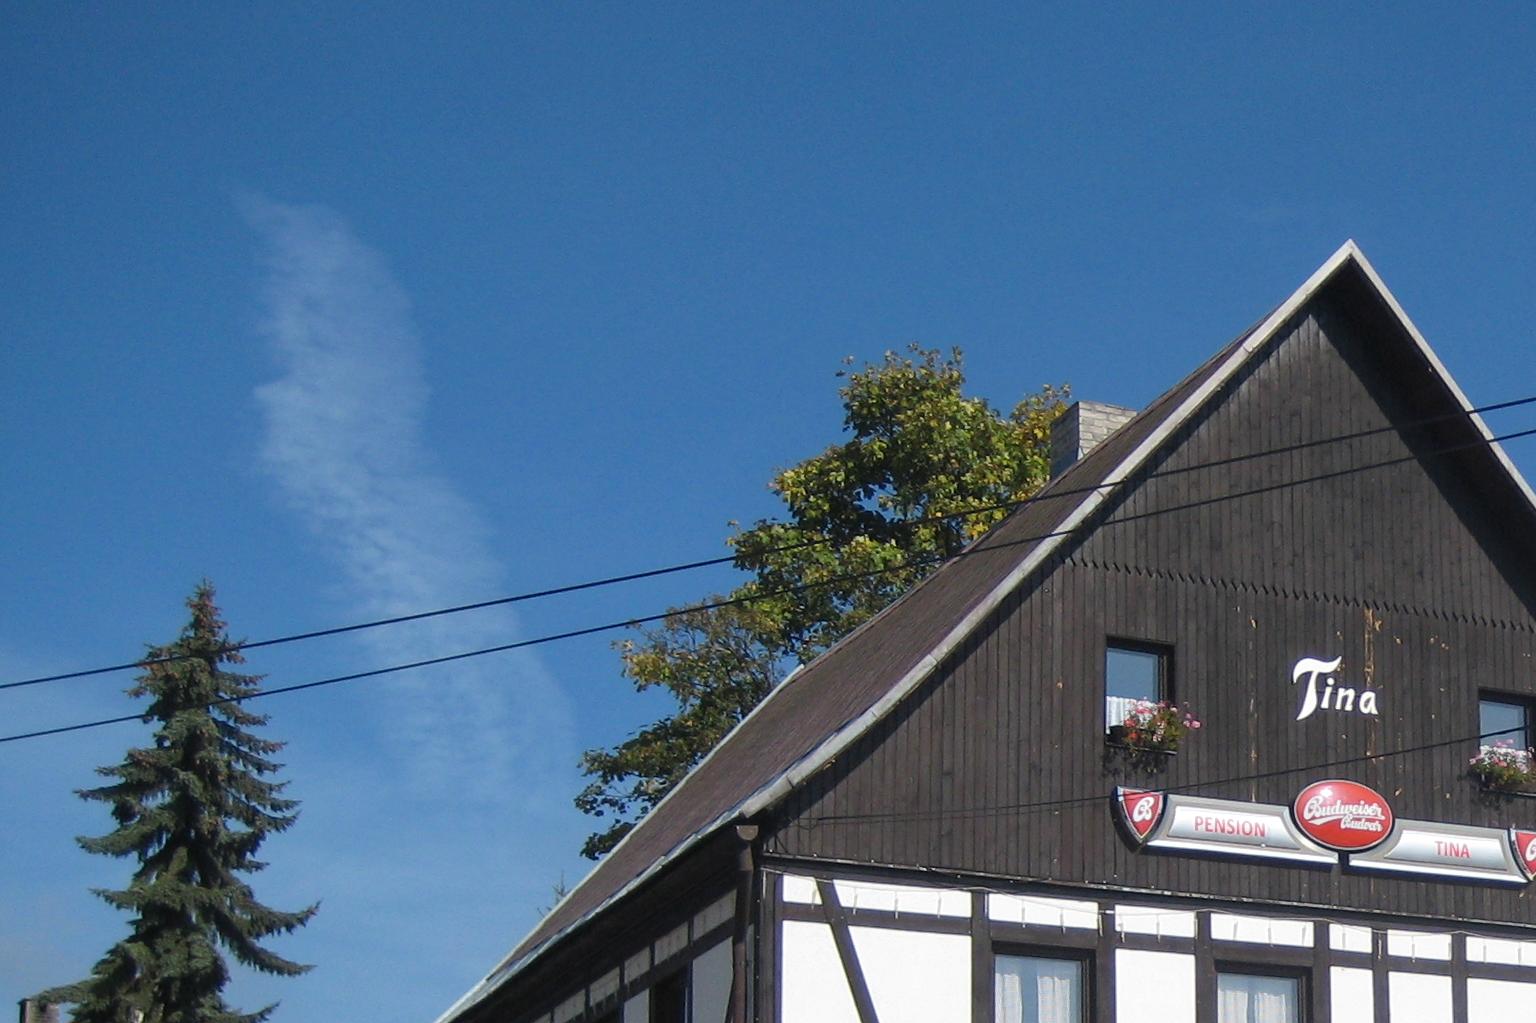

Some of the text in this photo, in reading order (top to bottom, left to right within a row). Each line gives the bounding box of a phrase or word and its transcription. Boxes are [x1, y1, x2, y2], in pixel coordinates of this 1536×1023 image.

[1293, 656, 1378, 720] Tina
[1303, 795, 1385, 821] Budweiser
[1194, 816, 1266, 837] PENSION
[1340, 814, 1383, 832] Budvar
[1434, 841, 1470, 858] TINA
